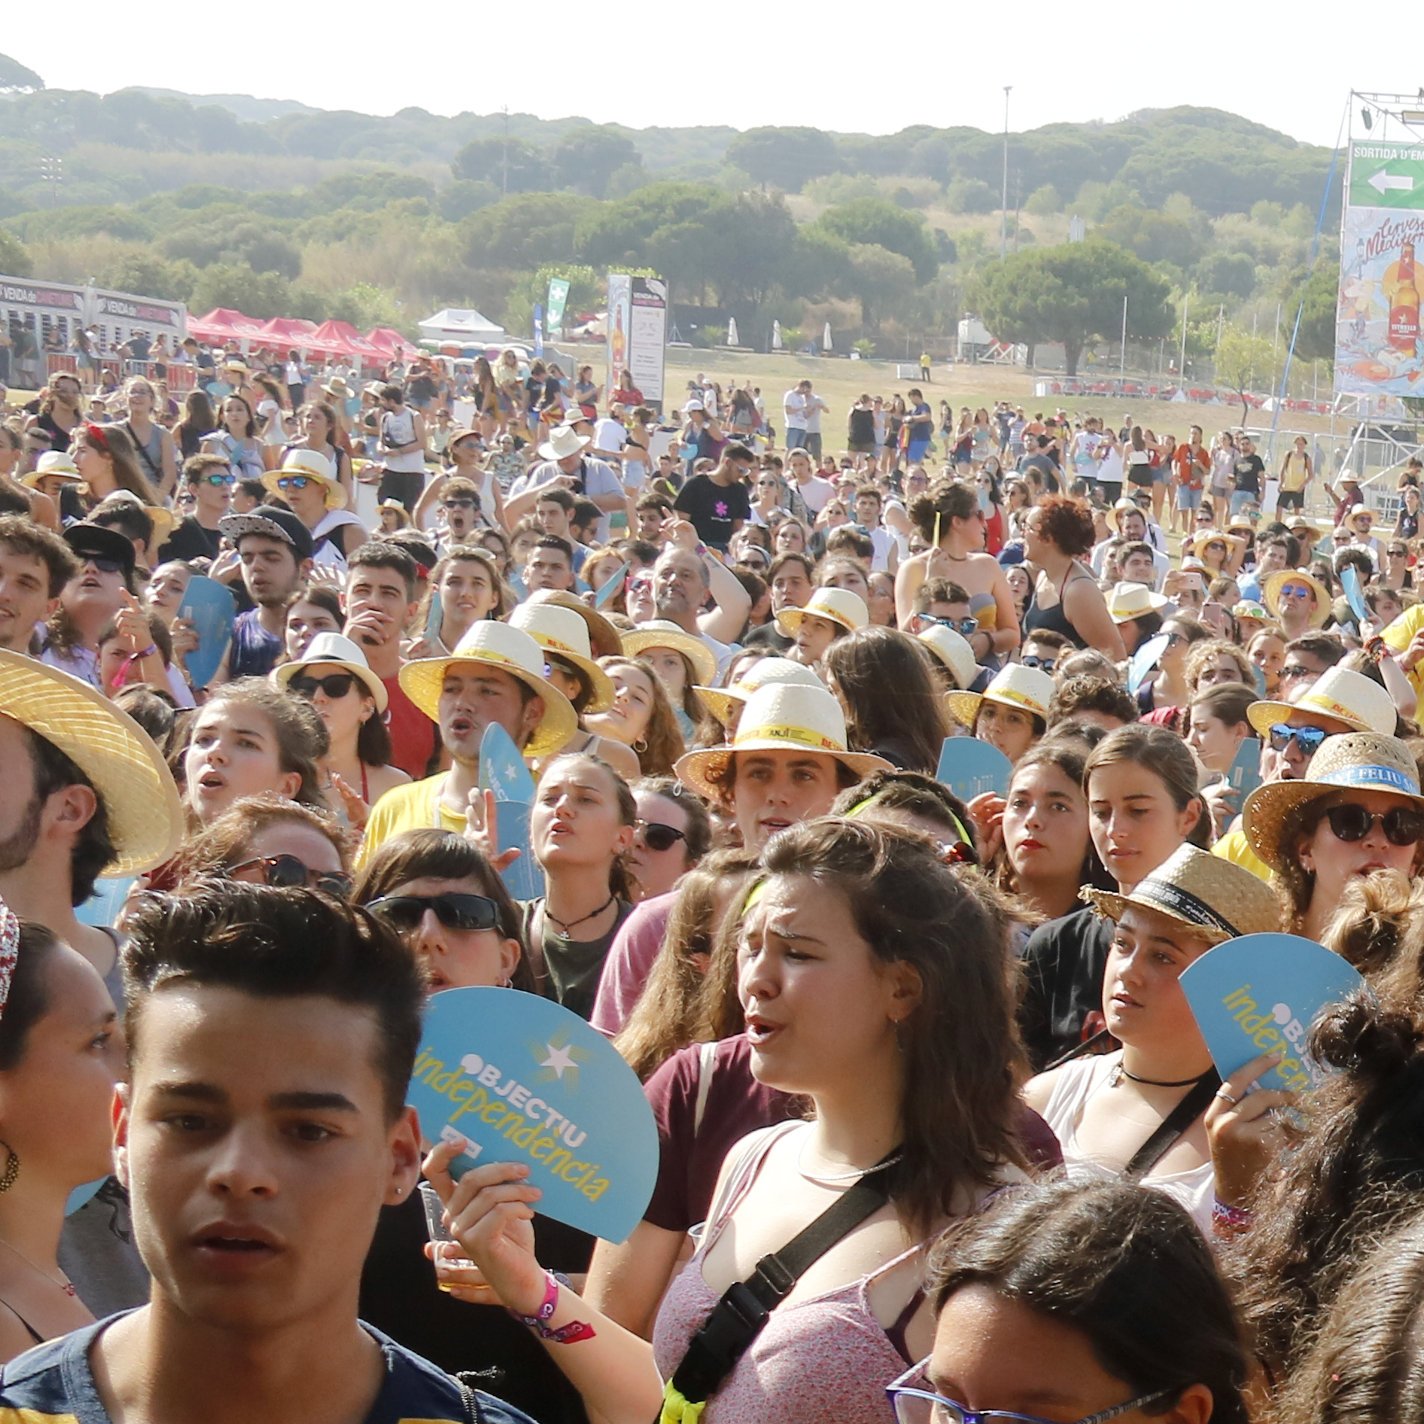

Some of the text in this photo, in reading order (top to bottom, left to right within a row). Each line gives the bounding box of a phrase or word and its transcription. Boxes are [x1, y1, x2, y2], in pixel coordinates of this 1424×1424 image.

[1353, 146, 1397, 160] SORTIDA
[4, 286, 27, 301] VENDA
[107, 300, 129, 314] VENDA
[1359, 767, 1402, 786] FELIU
[461, 1053, 588, 1148] OBJECTIU
